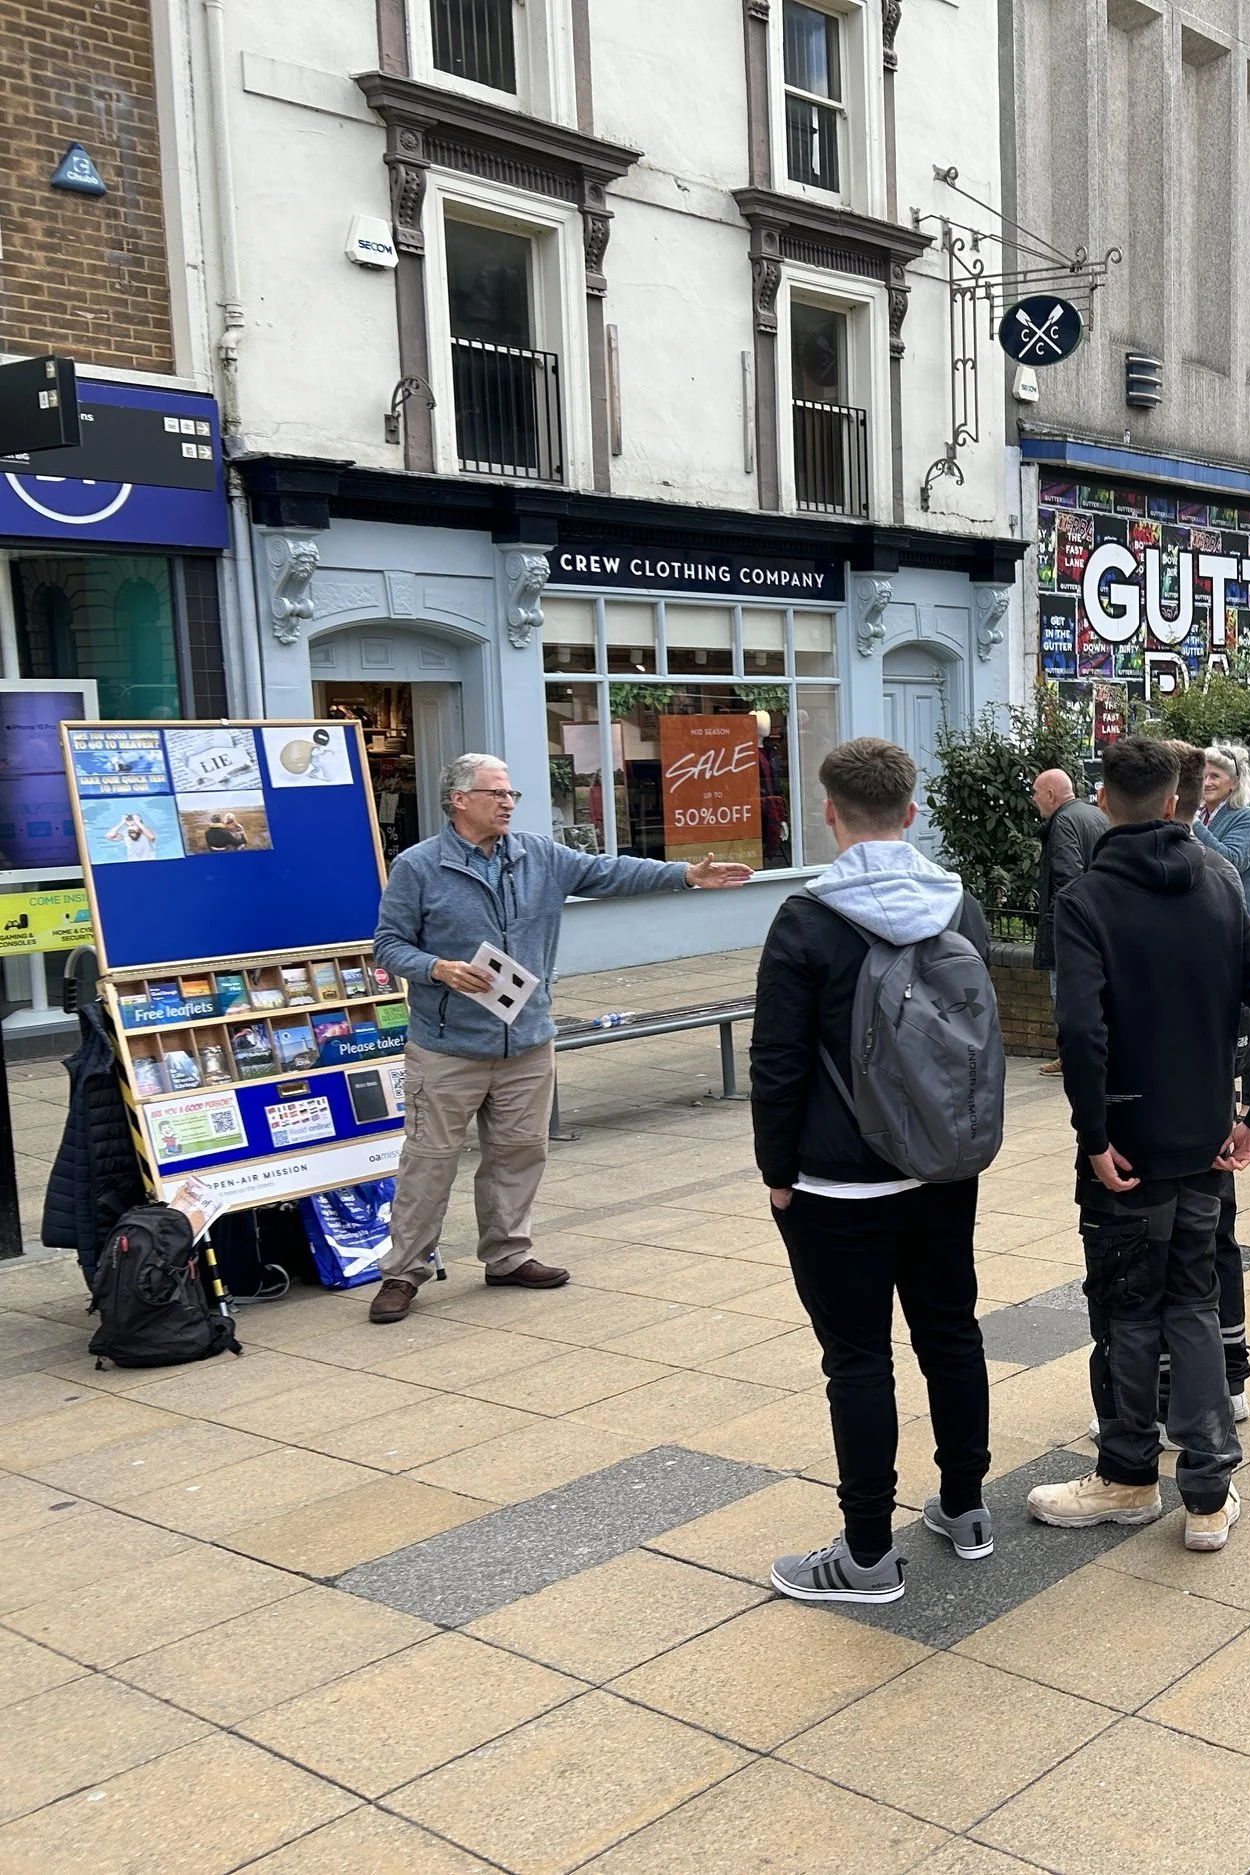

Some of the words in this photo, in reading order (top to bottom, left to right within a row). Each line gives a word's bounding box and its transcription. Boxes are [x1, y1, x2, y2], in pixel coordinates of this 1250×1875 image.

[67, 171, 98, 185] Chubb
[358, 239, 393, 255] SECOM
[1066, 545, 1083, 555] FAST
[1065, 558, 1085, 568] LANE
[560, 553, 620, 573] CREW
[630, 559, 731, 582] CLOTHING
[740, 567, 824, 588] COMPANY
[1050, 615, 1066, 627] GET
[1045, 629, 1055, 639] IN
[1055, 629, 1072, 640] THE
[1043, 642, 1073, 652] GUTTER
[1083, 644, 1107, 653] DOWN
[1103, 712, 1119, 722] FAST
[691, 728, 703, 736] MID
[704, 728, 731, 736] SEASON
[1101, 725, 1121, 735] LANE
[74, 740, 87, 750] TO
[88, 740, 103, 750] GO
[104, 740, 118, 750] TO
[200, 755, 234, 775] LIE
[666, 741, 757, 794] SALE
[713, 791, 723, 799] TO
[29, 896, 61, 907] COME
[63, 894, 88, 904] INSI
[61, 933, 94, 942] SECURITY
[135, 1009, 164, 1022] Free
[166, 1002, 214, 1018] leaflets
[339, 1041, 376, 1056] Please
[377, 1035, 405, 1050] take!
[967, 1044, 977, 1086] UNDER
[165, 1107, 178, 1115] YOU
[185, 1102, 204, 1112] GOOD
[968, 1088, 978, 1140] ARMOUR
[369, 1150, 402, 1163] oamiss
[263, 1164, 309, 1179] MISSION
